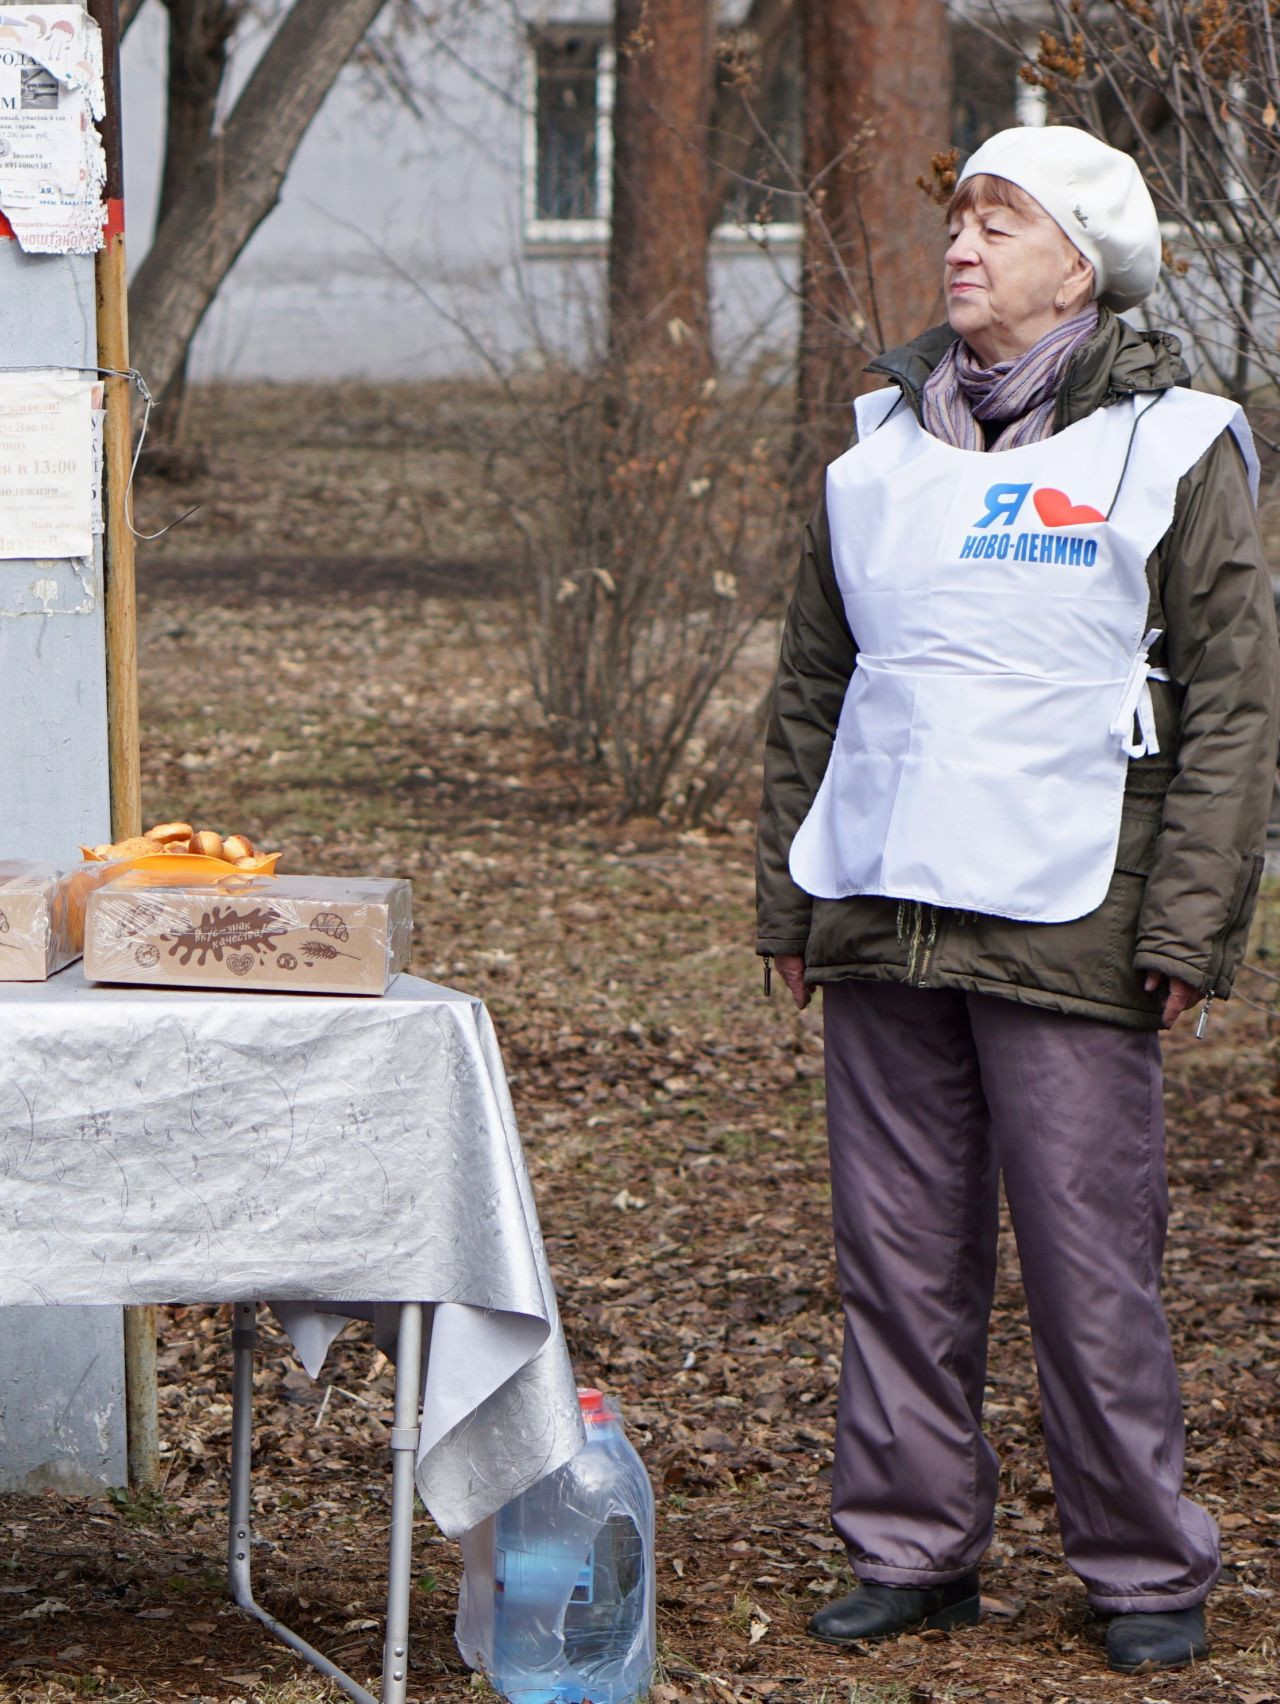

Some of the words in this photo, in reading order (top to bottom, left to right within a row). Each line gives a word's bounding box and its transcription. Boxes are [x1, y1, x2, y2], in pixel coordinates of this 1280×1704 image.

[33, 459, 77, 474] 13:00
[972, 483, 1033, 528] Я
[959, 533, 1098, 567] НОВО-ЛЕНИНО
